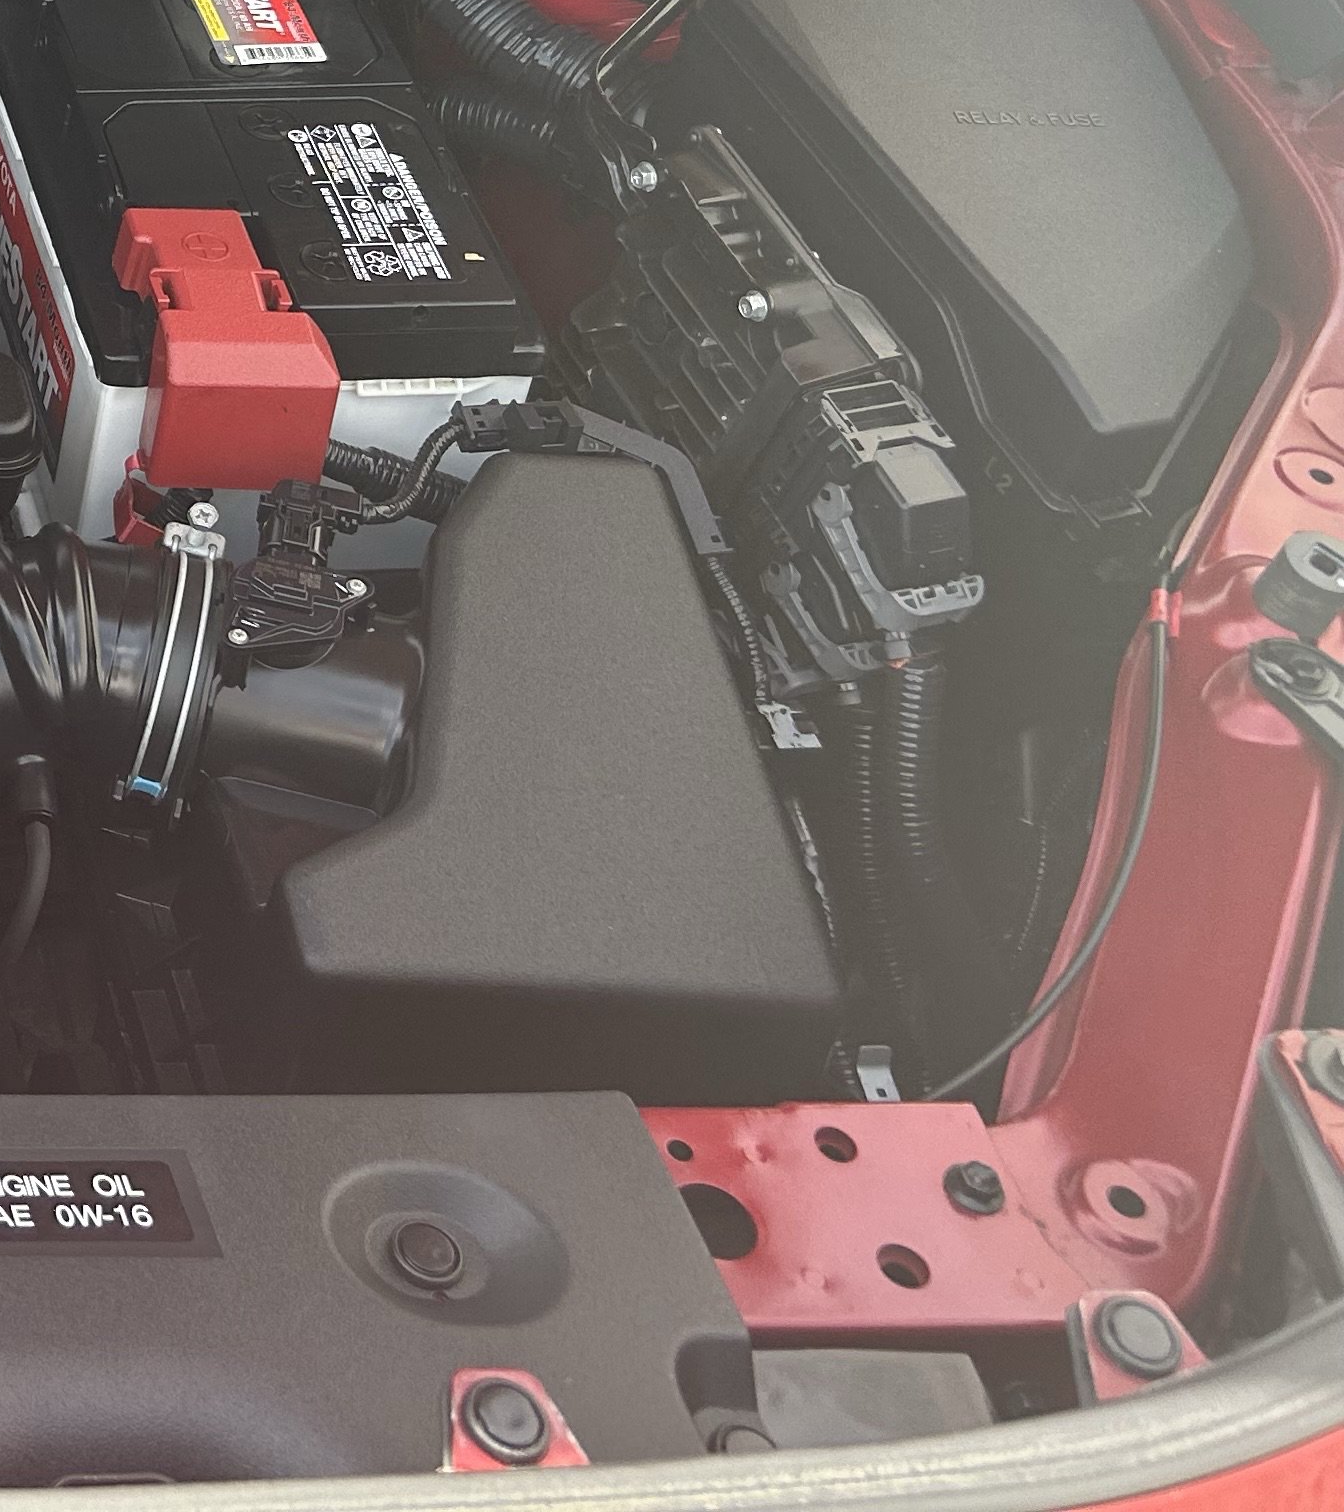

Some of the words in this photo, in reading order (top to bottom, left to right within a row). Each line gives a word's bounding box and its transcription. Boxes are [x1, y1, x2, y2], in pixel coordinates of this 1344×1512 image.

[952, 109, 1023, 126] RELAY
[1045, 112, 1107, 128] FUSE
[92, 1174, 145, 1198] OIL
[54, 1204, 154, 1228] 0W-16
